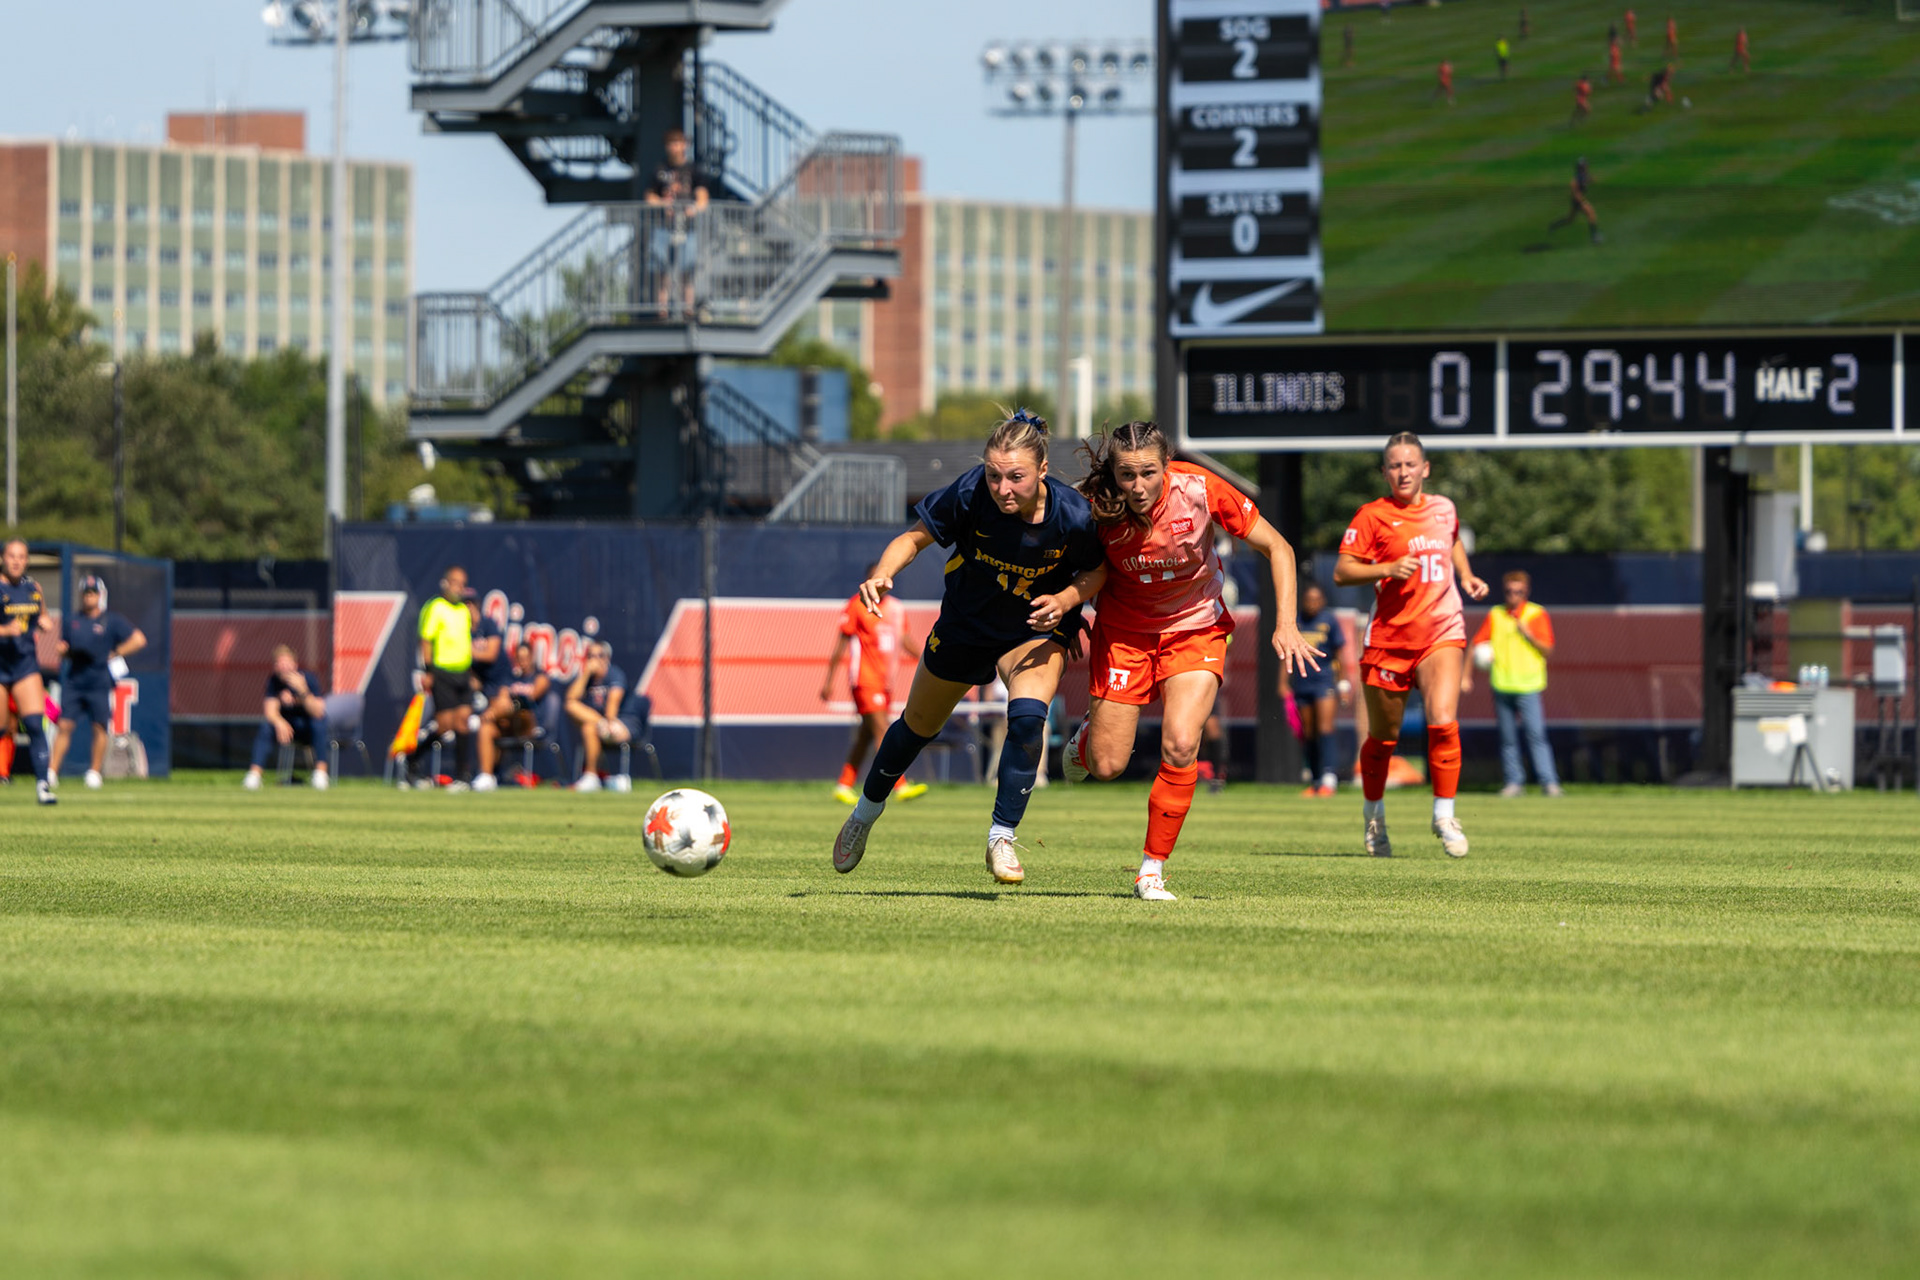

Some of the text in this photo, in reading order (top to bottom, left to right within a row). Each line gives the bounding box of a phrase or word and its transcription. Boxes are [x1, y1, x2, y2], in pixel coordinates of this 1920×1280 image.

[1219, 17, 1271, 41] SOG
[1232, 40, 1258, 78] 2
[1190, 105, 1299, 128] CORNERS
[1232, 128, 1258, 167] 2
[1207, 193, 1283, 216] SAVES
[1232, 214, 1259, 254] 0
[1213, 351, 1470, 427] ILLINOIS 0
[1532, 349, 1736, 427] 29:44
[1756, 353, 1858, 413] HALF 2
[1420, 554, 1444, 583] 16
